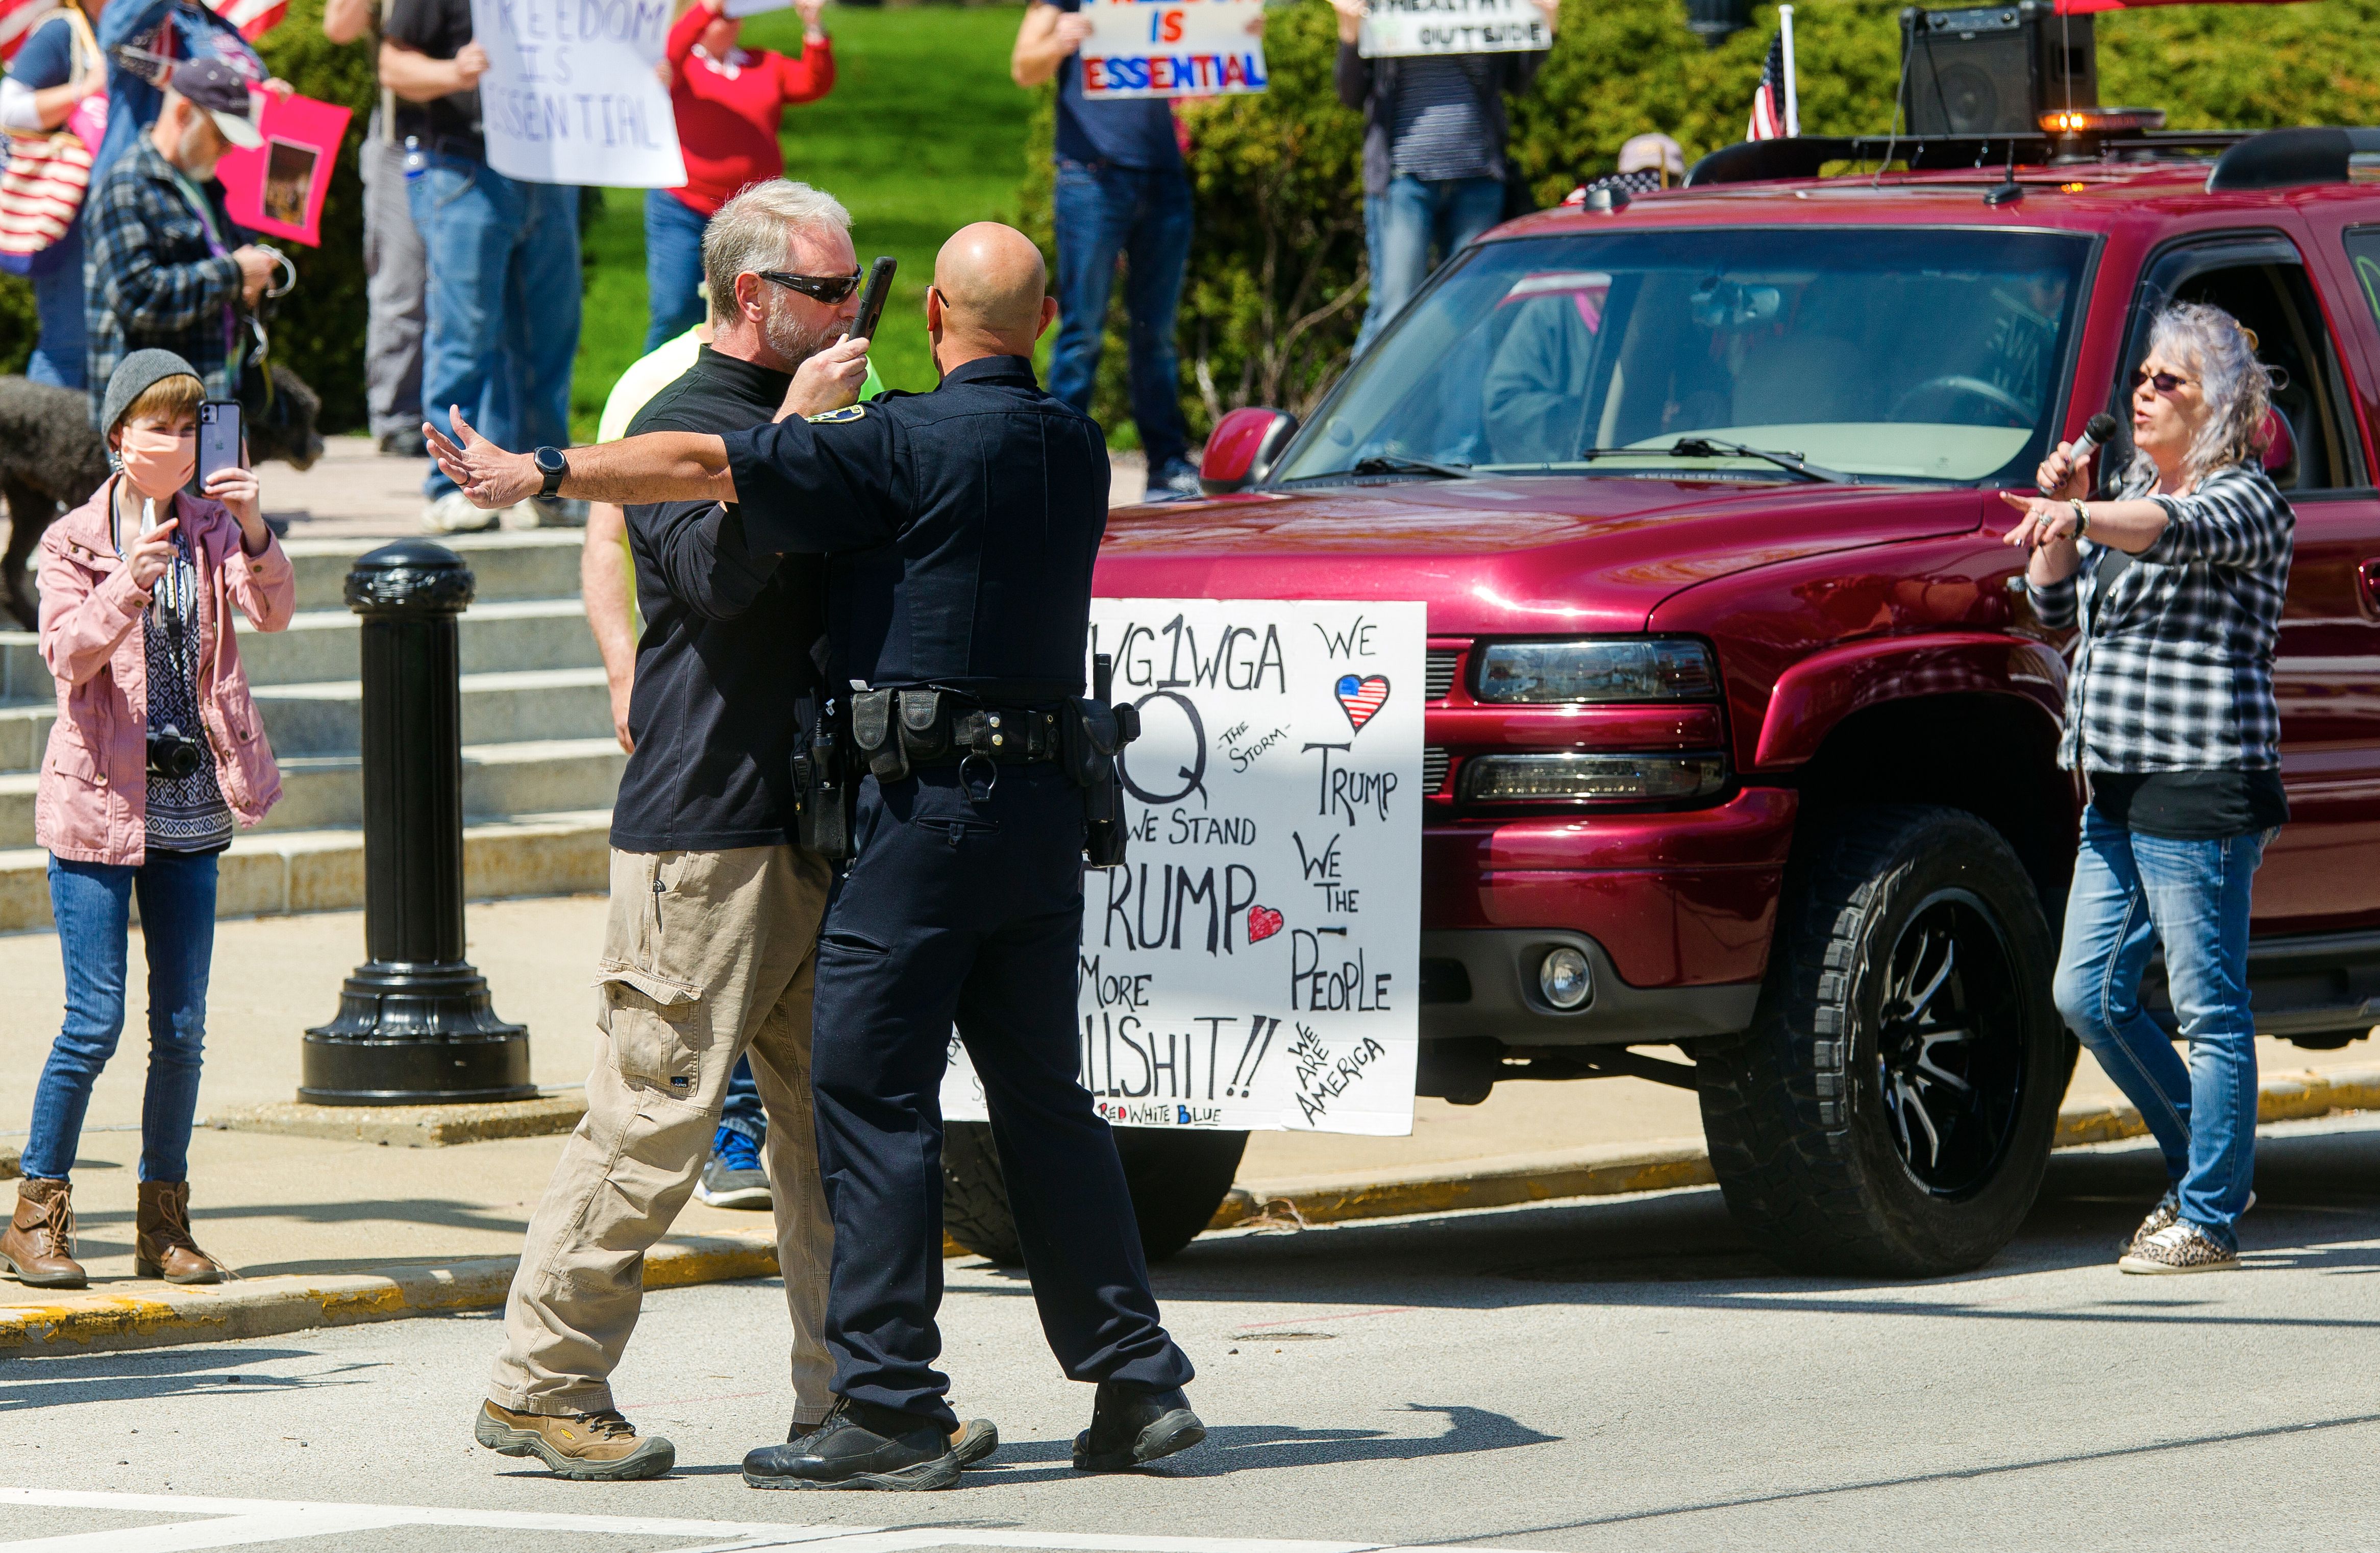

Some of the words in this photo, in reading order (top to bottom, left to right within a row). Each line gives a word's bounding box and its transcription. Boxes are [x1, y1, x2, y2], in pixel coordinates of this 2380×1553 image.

[1150, 9, 1184, 43] IS
[514, 43, 575, 86] IS
[1082, 54, 1267, 90] ESSENTIAL
[486, 82, 662, 151] ESSENTIAL
[1313, 615, 1377, 659] WE
[1117, 690, 1207, 810] Q
[1301, 742, 1398, 826] TRUMP
[1126, 809, 1159, 842] WE
[1169, 808, 1256, 845] STAND
[1292, 831, 1342, 880] WE
[1313, 882, 1359, 913] THE
[1078, 955, 1152, 1013] MORE
[1292, 929, 1392, 1012] PEOPLE
[1287, 1021, 1318, 1057] WE
[1296, 1039, 1329, 1091] ARE
[1296, 1037, 1385, 1127] AMERICA
[1098, 1102, 1127, 1122] RED
[1177, 1104, 1221, 1125] BLUE
